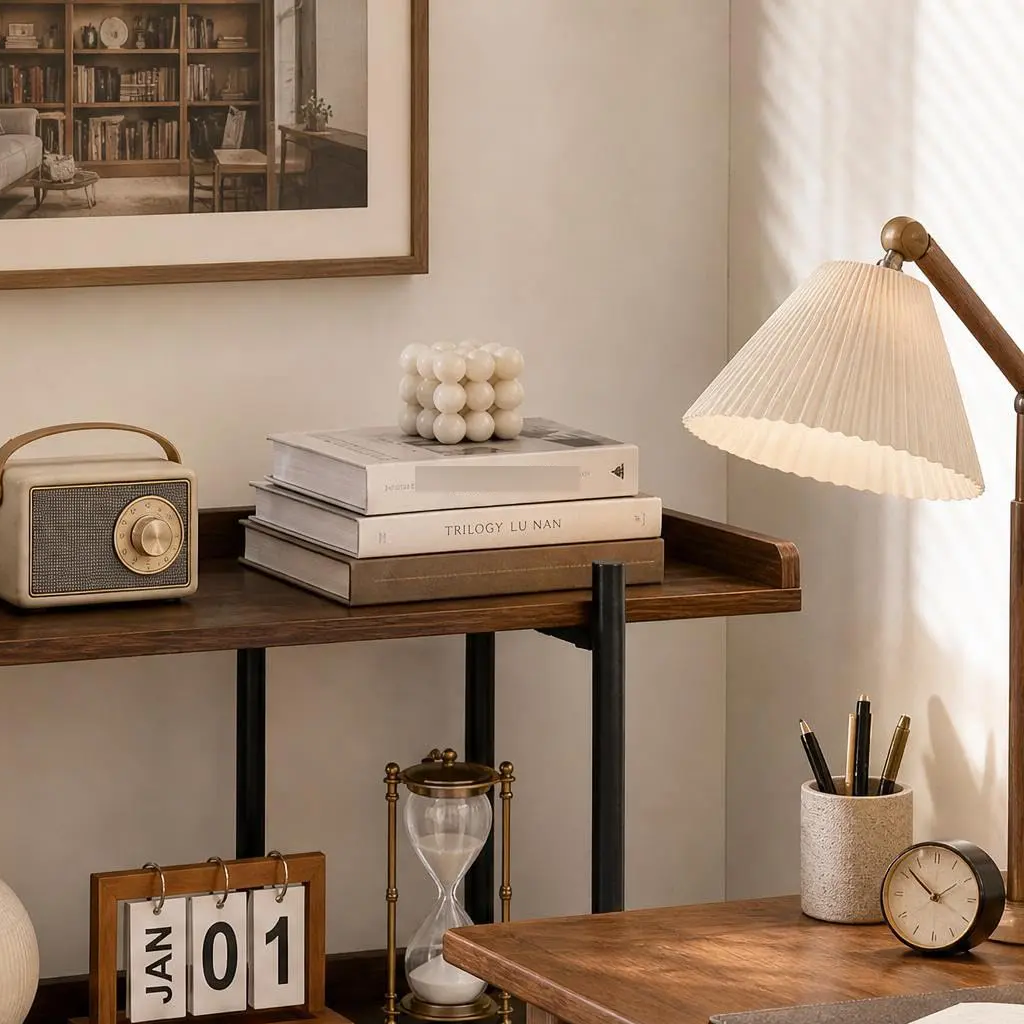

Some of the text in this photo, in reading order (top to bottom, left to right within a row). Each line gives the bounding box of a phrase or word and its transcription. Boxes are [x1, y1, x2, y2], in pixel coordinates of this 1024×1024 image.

[445, 518, 563, 537] TRILOGY LU NAN
[145, 926, 173, 1004] JAN
